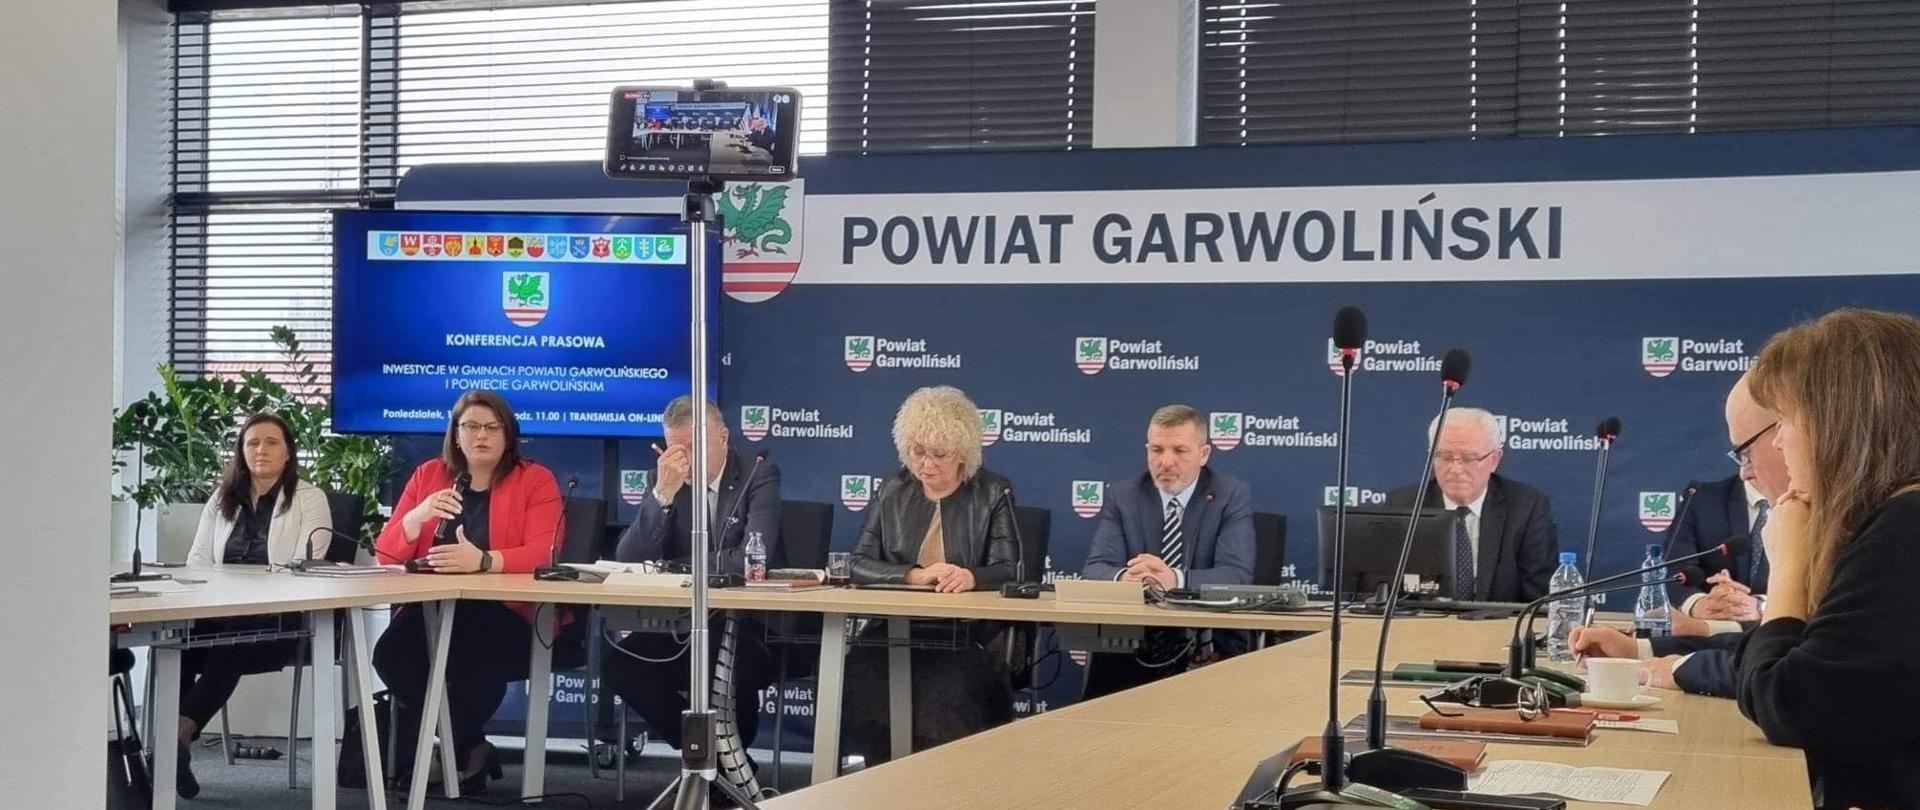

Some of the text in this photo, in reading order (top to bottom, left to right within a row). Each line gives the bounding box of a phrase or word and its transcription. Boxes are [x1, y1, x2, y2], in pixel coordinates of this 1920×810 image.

[842, 192, 1563, 266] POWIAT GARWOLIŃSKI
[446, 334, 605, 348] KONFERENCJA PRASOWA
[877, 338, 926, 352] Powiat
[1110, 340, 1162, 354] Powiat
[1364, 340, 1421, 354] Powiat
[1681, 338, 1744, 354] Powiat
[876, 353, 961, 368] Garwoliński
[1109, 355, 1199, 370] Garwoliński
[1364, 356, 1442, 371] Garwolińs
[1681, 356, 1755, 372] Garwoli
[382, 363, 669, 379] INWESTYCJE W GMINACH POWIATU GARWOLIŃSKIEGO
[452, 379, 509, 390] POWIECIE
[511, 379, 604, 392] GARWOLIŃSKIM
[536, 412, 560, 421] 11.00
[569, 412, 626, 422] TRANSMISJA
[772, 409, 820, 423] Powiat
[1003, 412, 1055, 426] Powiat
[1245, 415, 1299, 430] Powiat
[772, 424, 853, 438] Garwoliński
[1509, 418, 1568, 433] Powiat
[1003, 428, 1091, 443] Garwoliński
[1244, 432, 1338, 447] Garwoliński
[766, 685, 813, 700] Pwiat
